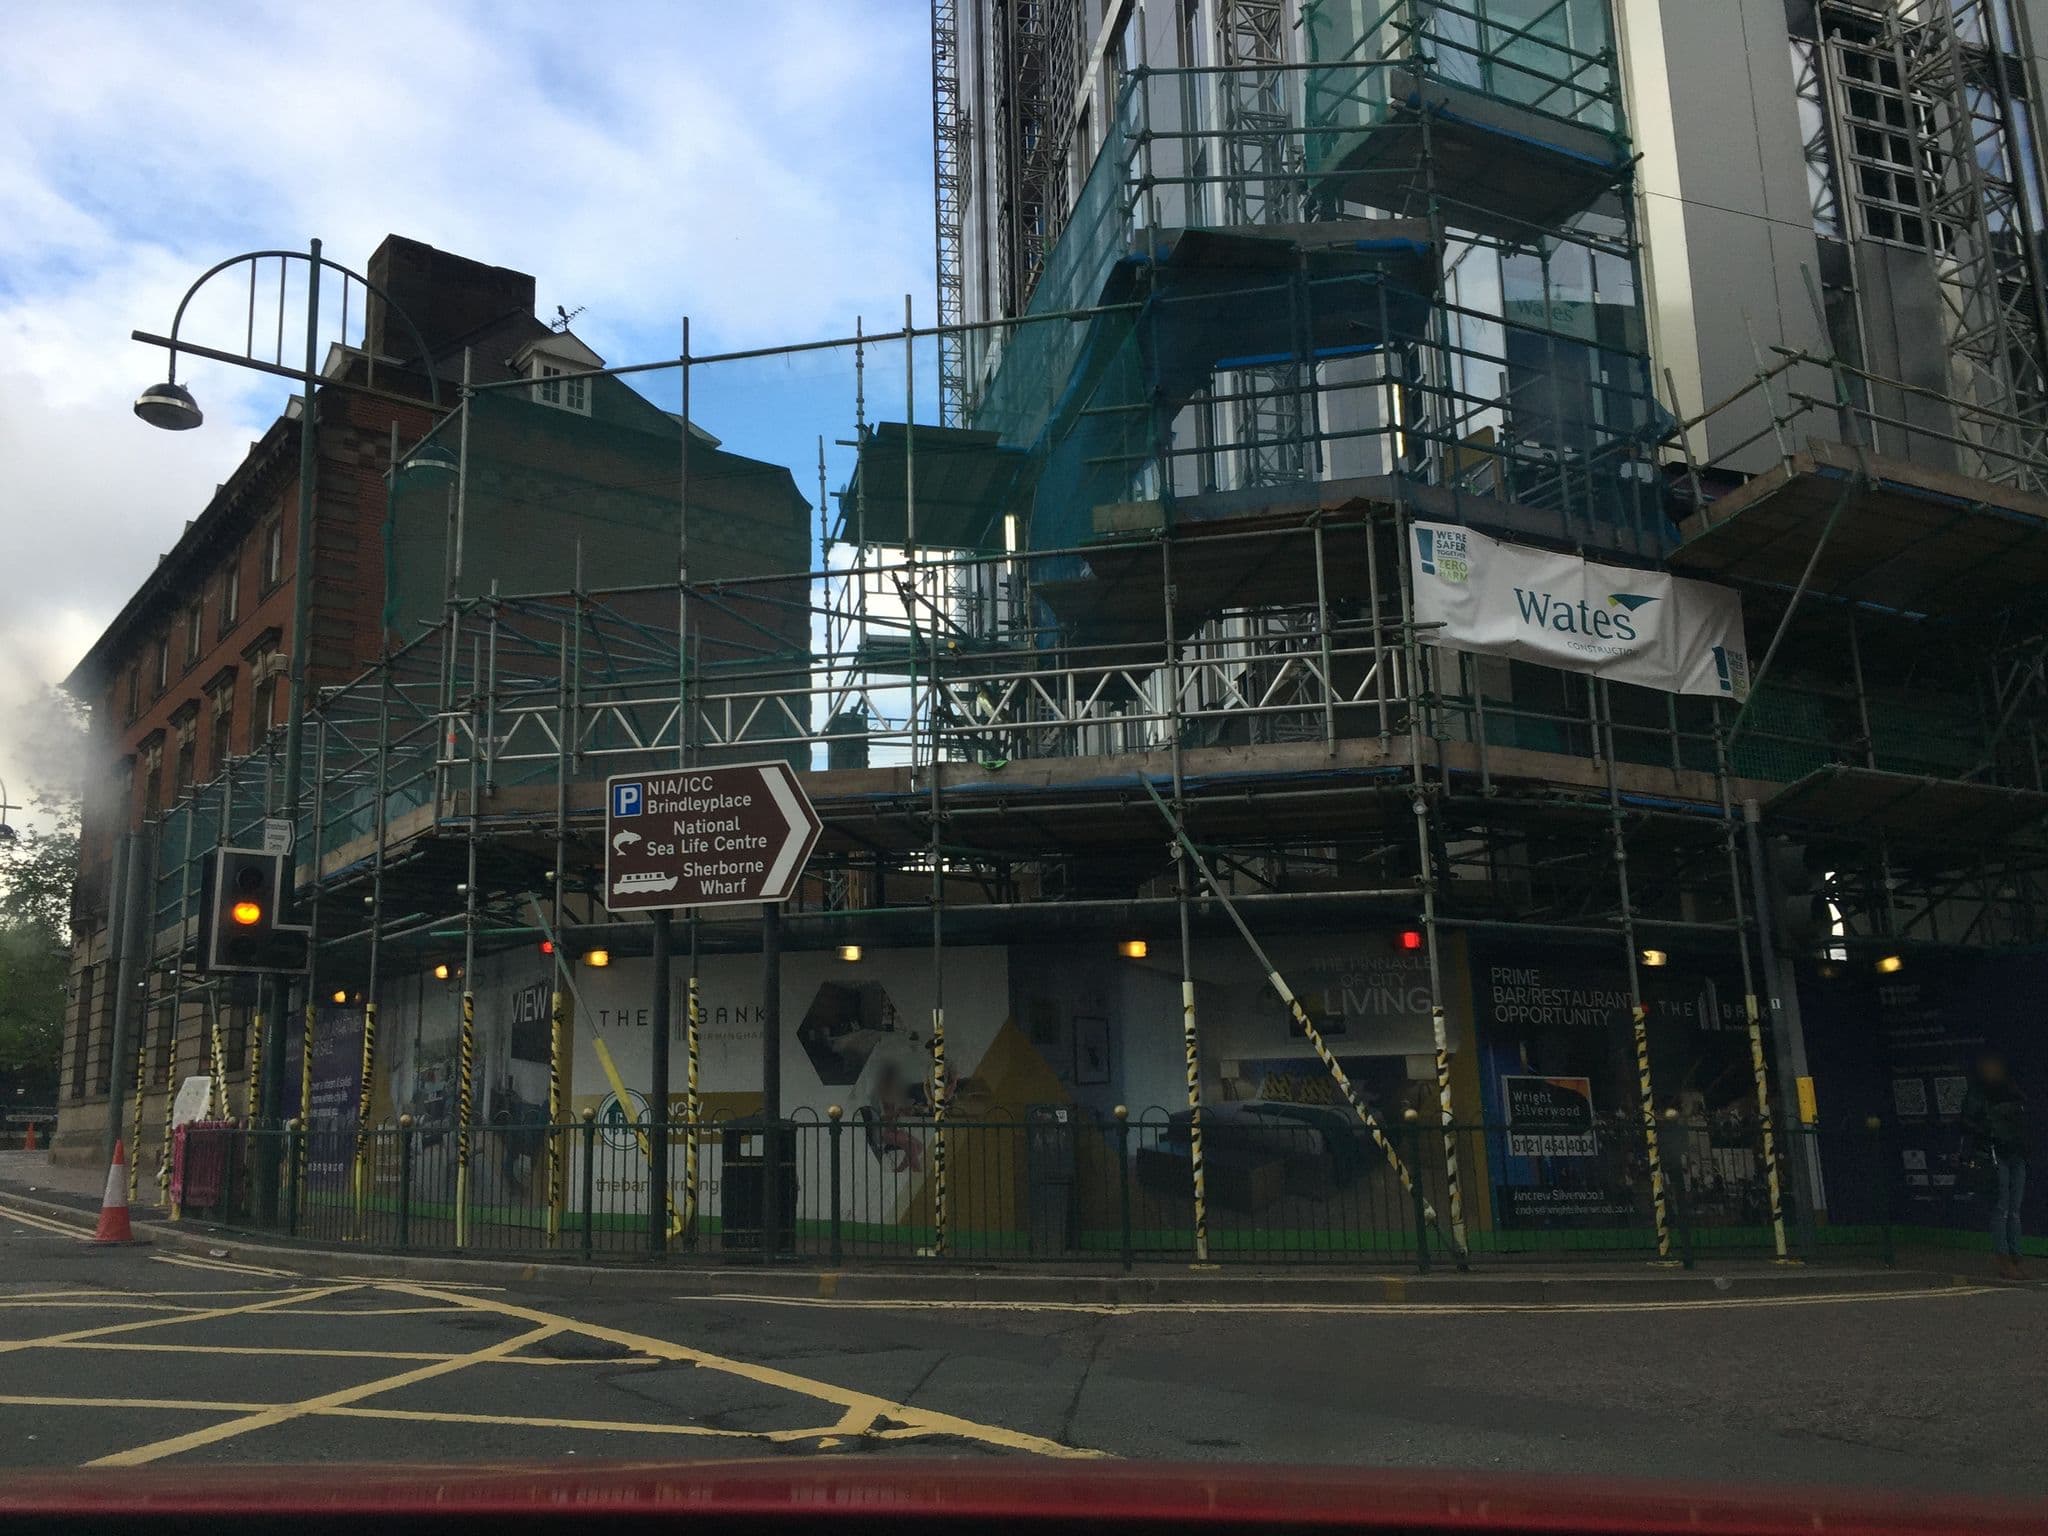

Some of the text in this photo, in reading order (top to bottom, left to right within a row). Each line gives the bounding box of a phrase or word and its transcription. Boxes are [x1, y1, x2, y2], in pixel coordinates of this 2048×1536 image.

[1436, 530, 1467, 543] WE'RE
[1436, 539, 1466, 553] SAFER
[1513, 587, 1637, 641] Wates
[647, 776, 714, 796] NIA/ICC
[647, 793, 752, 815] Brindleyplace
[673, 816, 741, 836] National
[646, 834, 768, 857] Sea Life Centre
[682, 859, 765, 877] Sherborne
[700, 878, 748, 896] Wharf
[1491, 967, 1541, 987] PRIME
[511, 985, 548, 1024] VIEW
[1323, 986, 1431, 1016] LIVING
[600, 1006, 767, 1027] THE BANK
[1495, 1006, 1610, 1026] OPPORTUNITY
[1512, 1091, 1552, 1106] Wright
[1514, 1104, 1581, 1118] Silverwood
